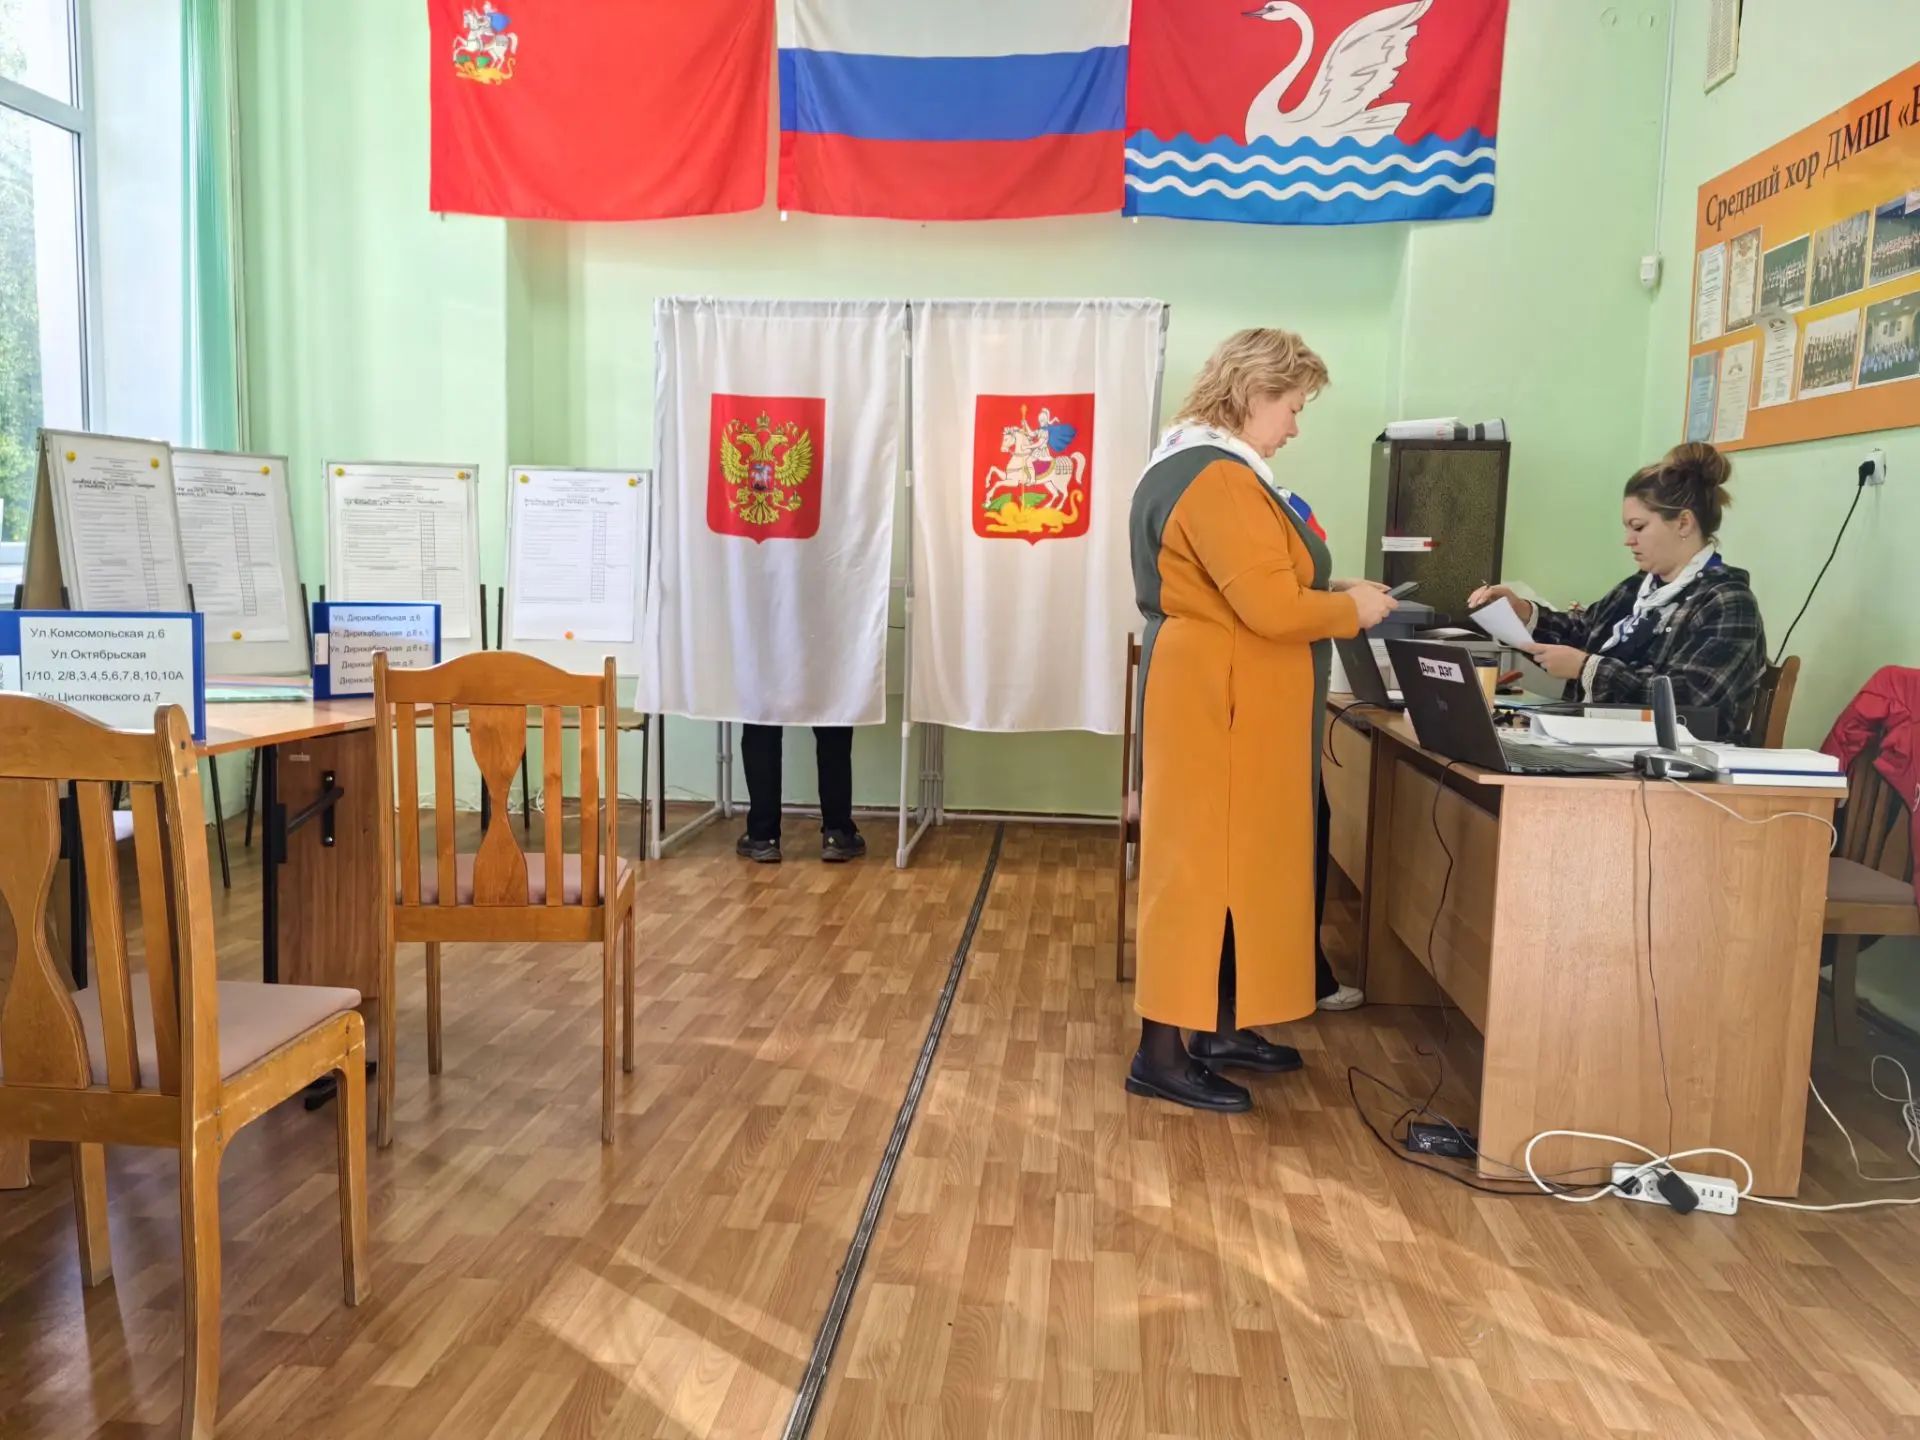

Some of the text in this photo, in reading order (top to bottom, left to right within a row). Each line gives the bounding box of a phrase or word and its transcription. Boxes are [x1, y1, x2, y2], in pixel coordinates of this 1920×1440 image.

[1706, 165, 1780, 231] Средний
[1784, 151, 1820, 190] хор
[1823, 99, 1893, 178] ДМШ
[30, 628, 165, 640] Ул.Комсомольская д.6
[51, 649, 147, 661] Ул.Октябрьская
[1421, 662, 1436, 675] Для
[26, 670, 54, 682] 1/10,
[142, 691, 161, 702] д.7
